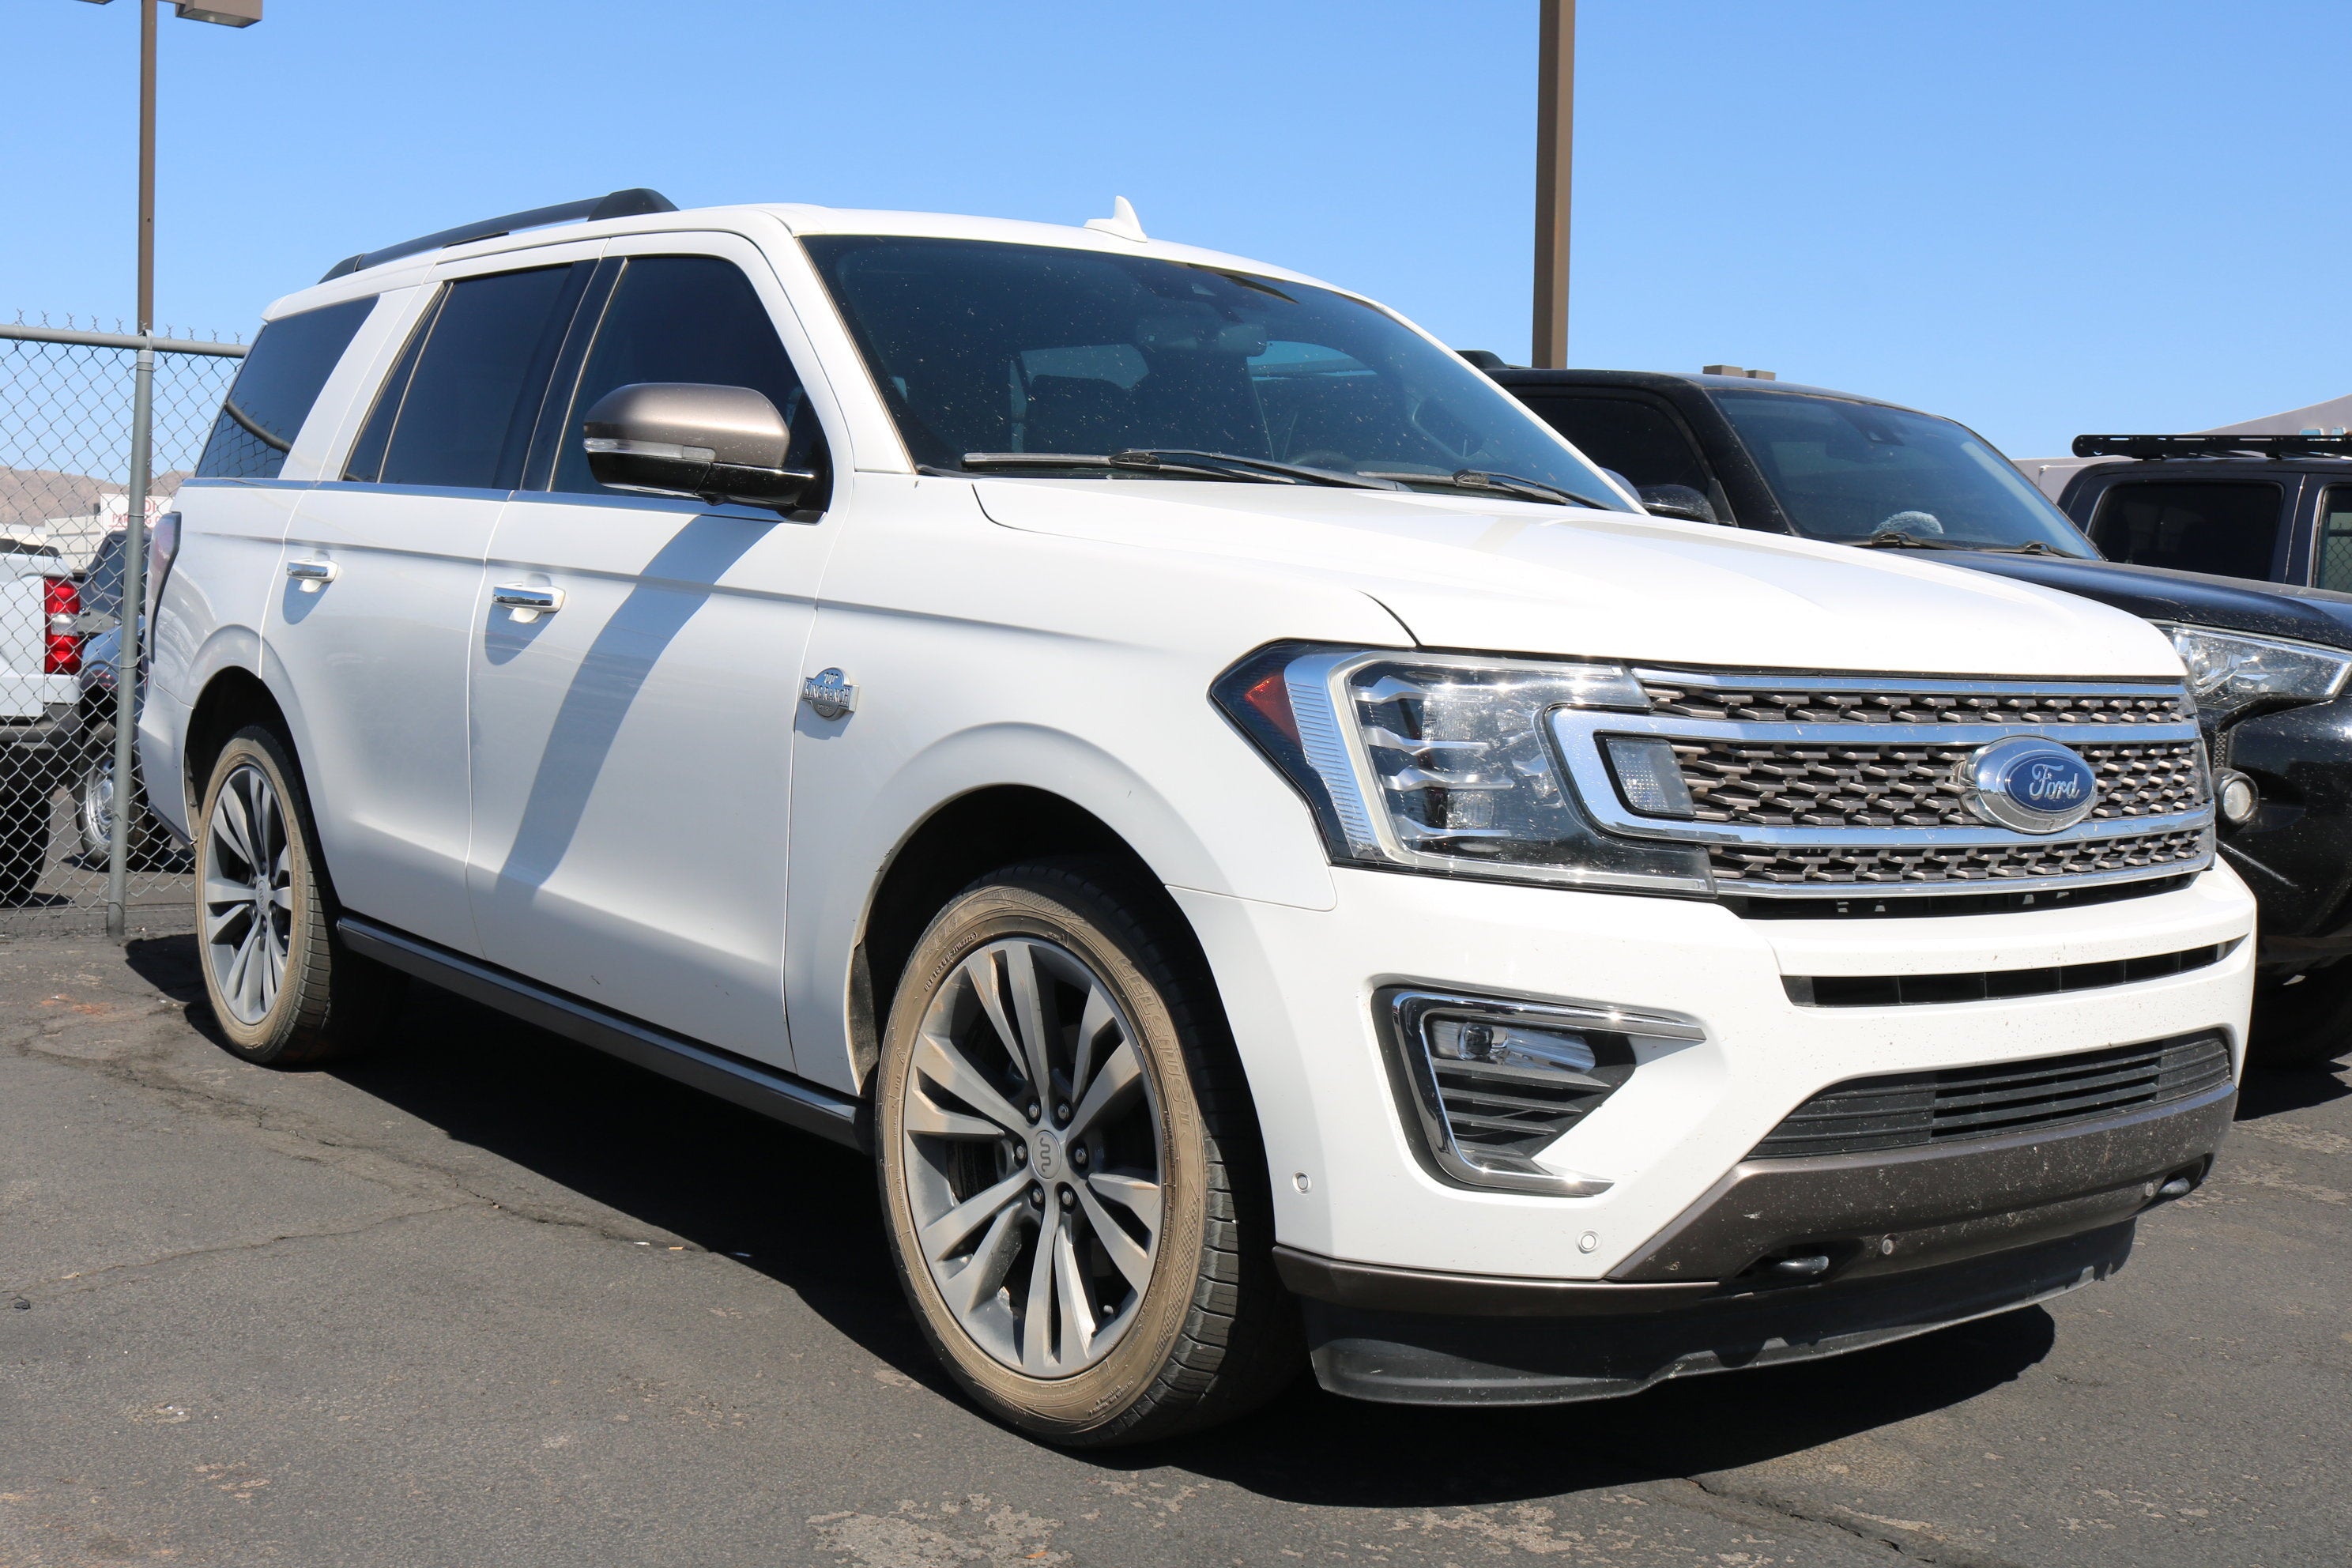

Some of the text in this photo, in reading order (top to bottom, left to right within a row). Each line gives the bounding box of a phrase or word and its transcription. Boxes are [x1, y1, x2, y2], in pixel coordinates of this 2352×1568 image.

[804, 680, 850, 705] KING RANCH
[2029, 763, 2080, 801] Ford
